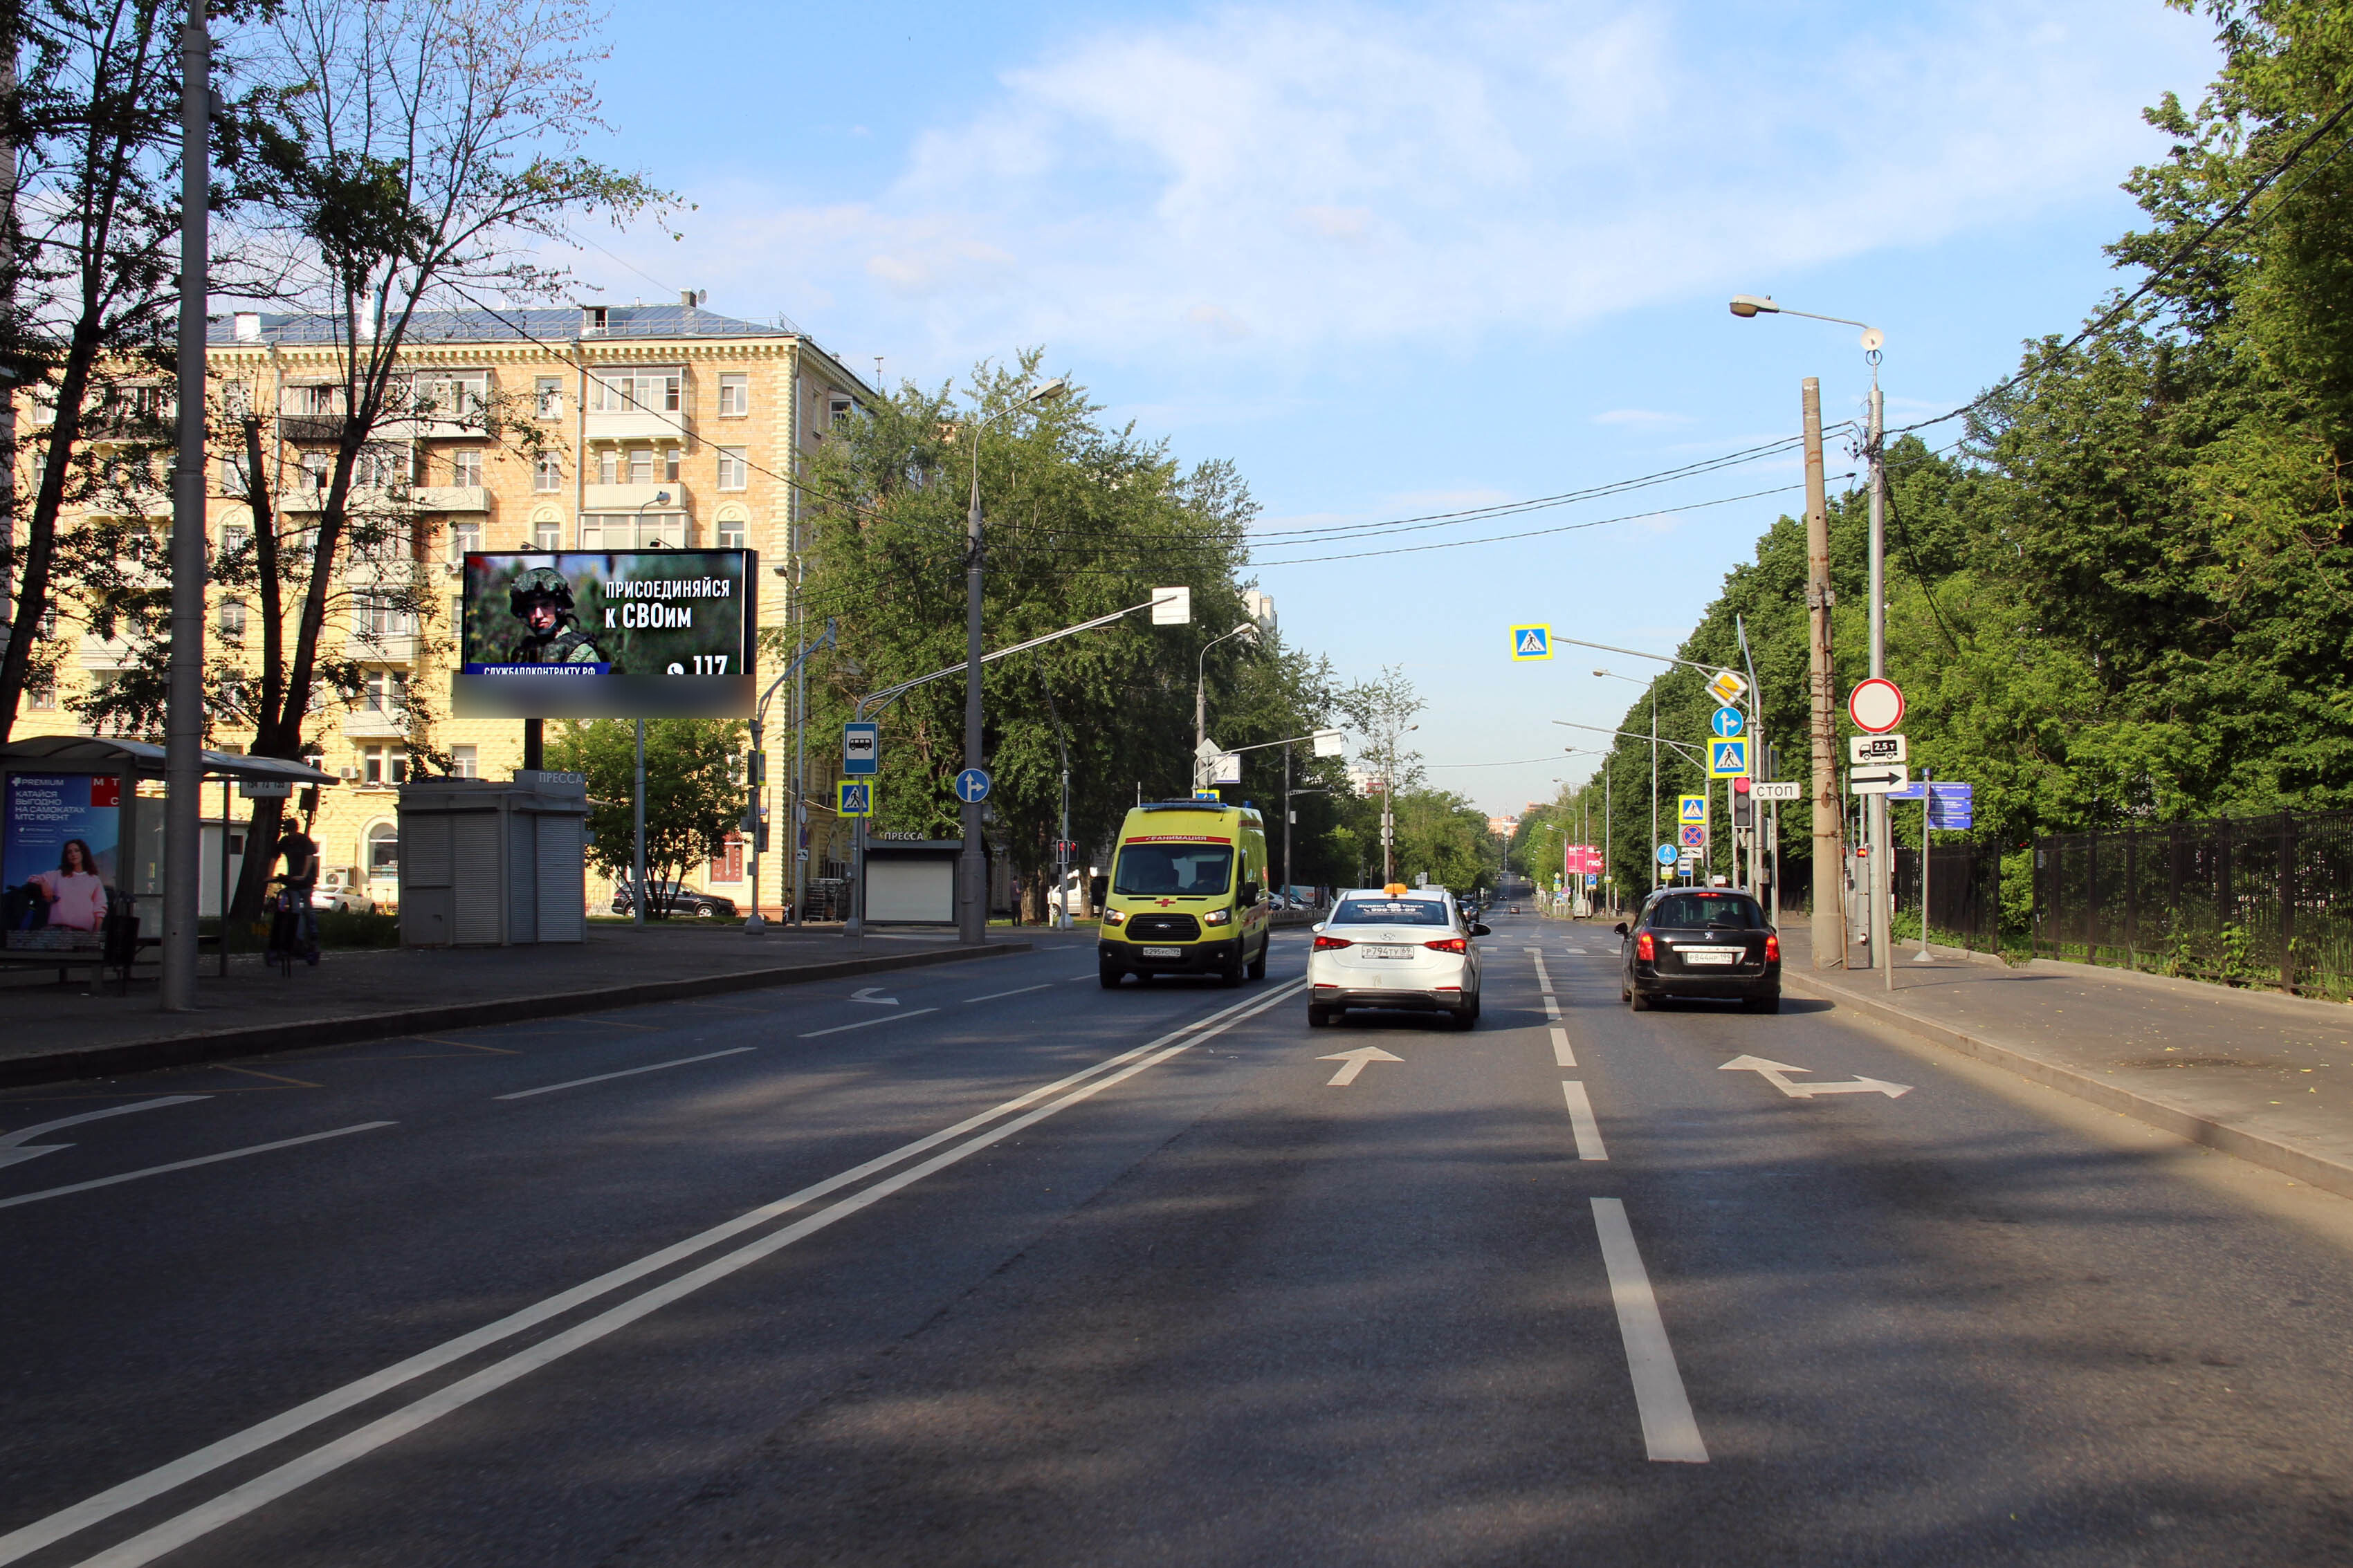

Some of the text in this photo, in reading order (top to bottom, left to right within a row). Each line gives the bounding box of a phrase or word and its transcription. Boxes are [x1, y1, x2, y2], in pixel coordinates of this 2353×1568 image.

[605, 577, 730, 600] ПРИСОЕДИНЯЙСЯ
[623, 602, 691, 629] СВОим
[693, 655, 729, 675] 117
[1874, 742, 1888, 752] 2,5
[538, 772, 583, 784] ПРЕССА
[16, 789, 58, 797] КАТАЙСЯ
[1757, 786, 1793, 797] СТОП
[884, 831, 924, 841] ПРЕССА
